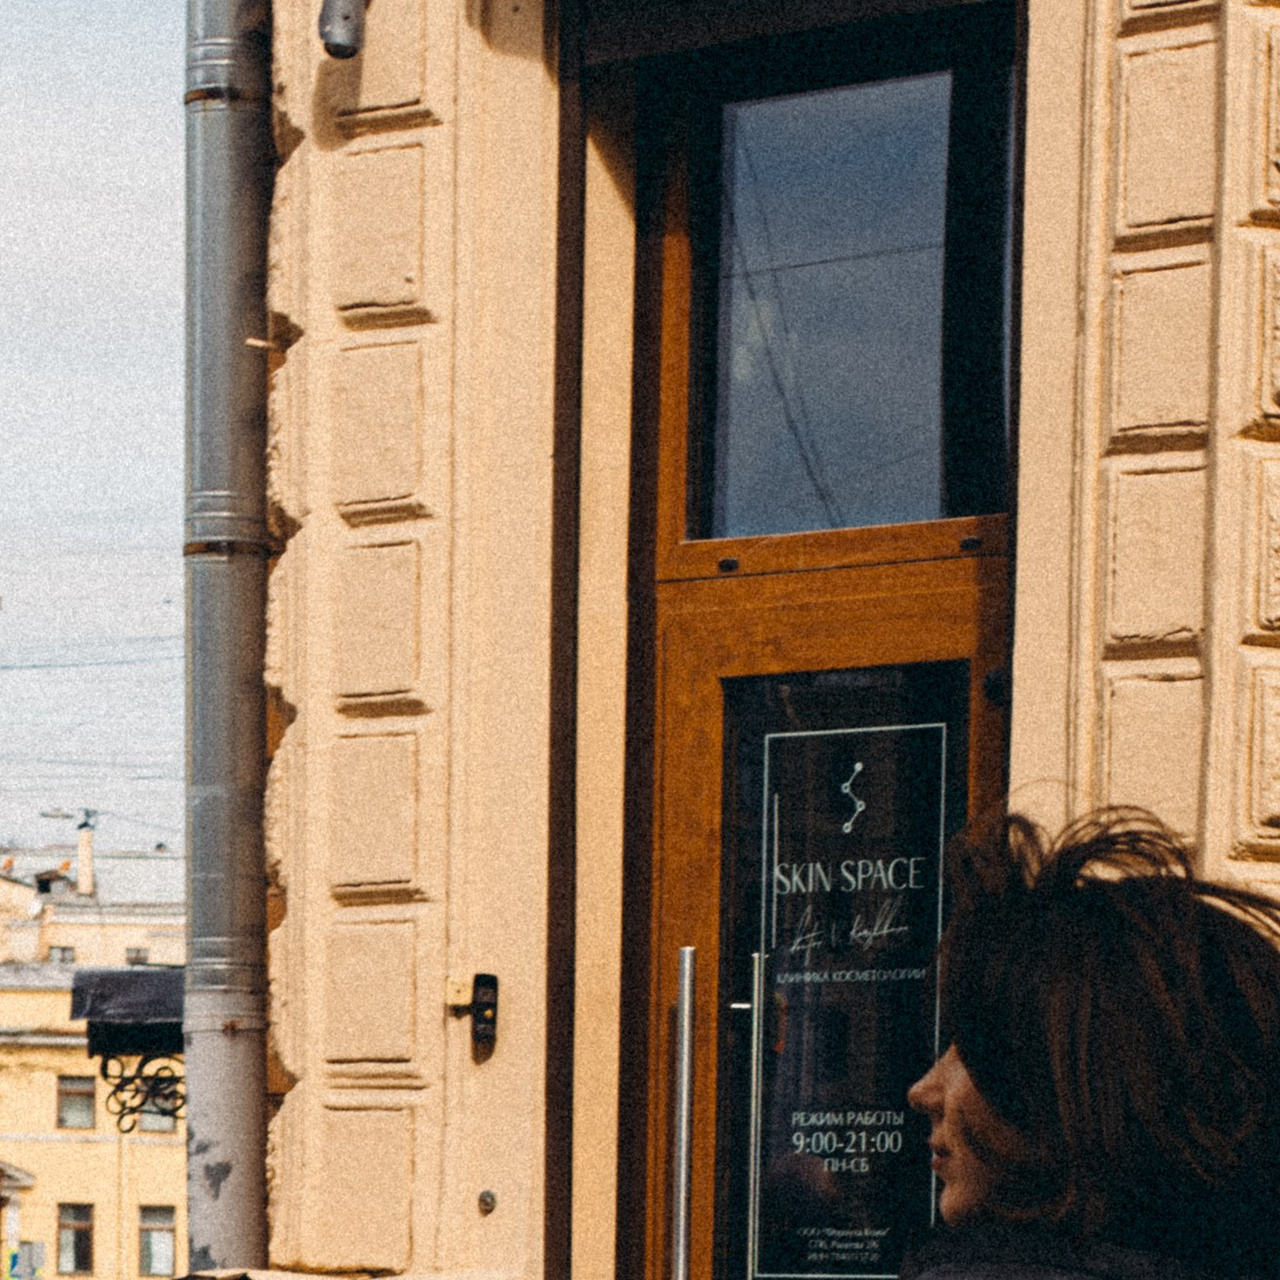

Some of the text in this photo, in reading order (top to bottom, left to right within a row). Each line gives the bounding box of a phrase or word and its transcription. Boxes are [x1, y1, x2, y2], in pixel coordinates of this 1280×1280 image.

[776, 857, 926, 895] SKIN SPACE
[791, 1111, 904, 1126] РЕЖИМ РАБОТЫ
[791, 1130, 903, 1154] 9:00-21:00
[823, 1157, 870, 1173] ПН-СБ
